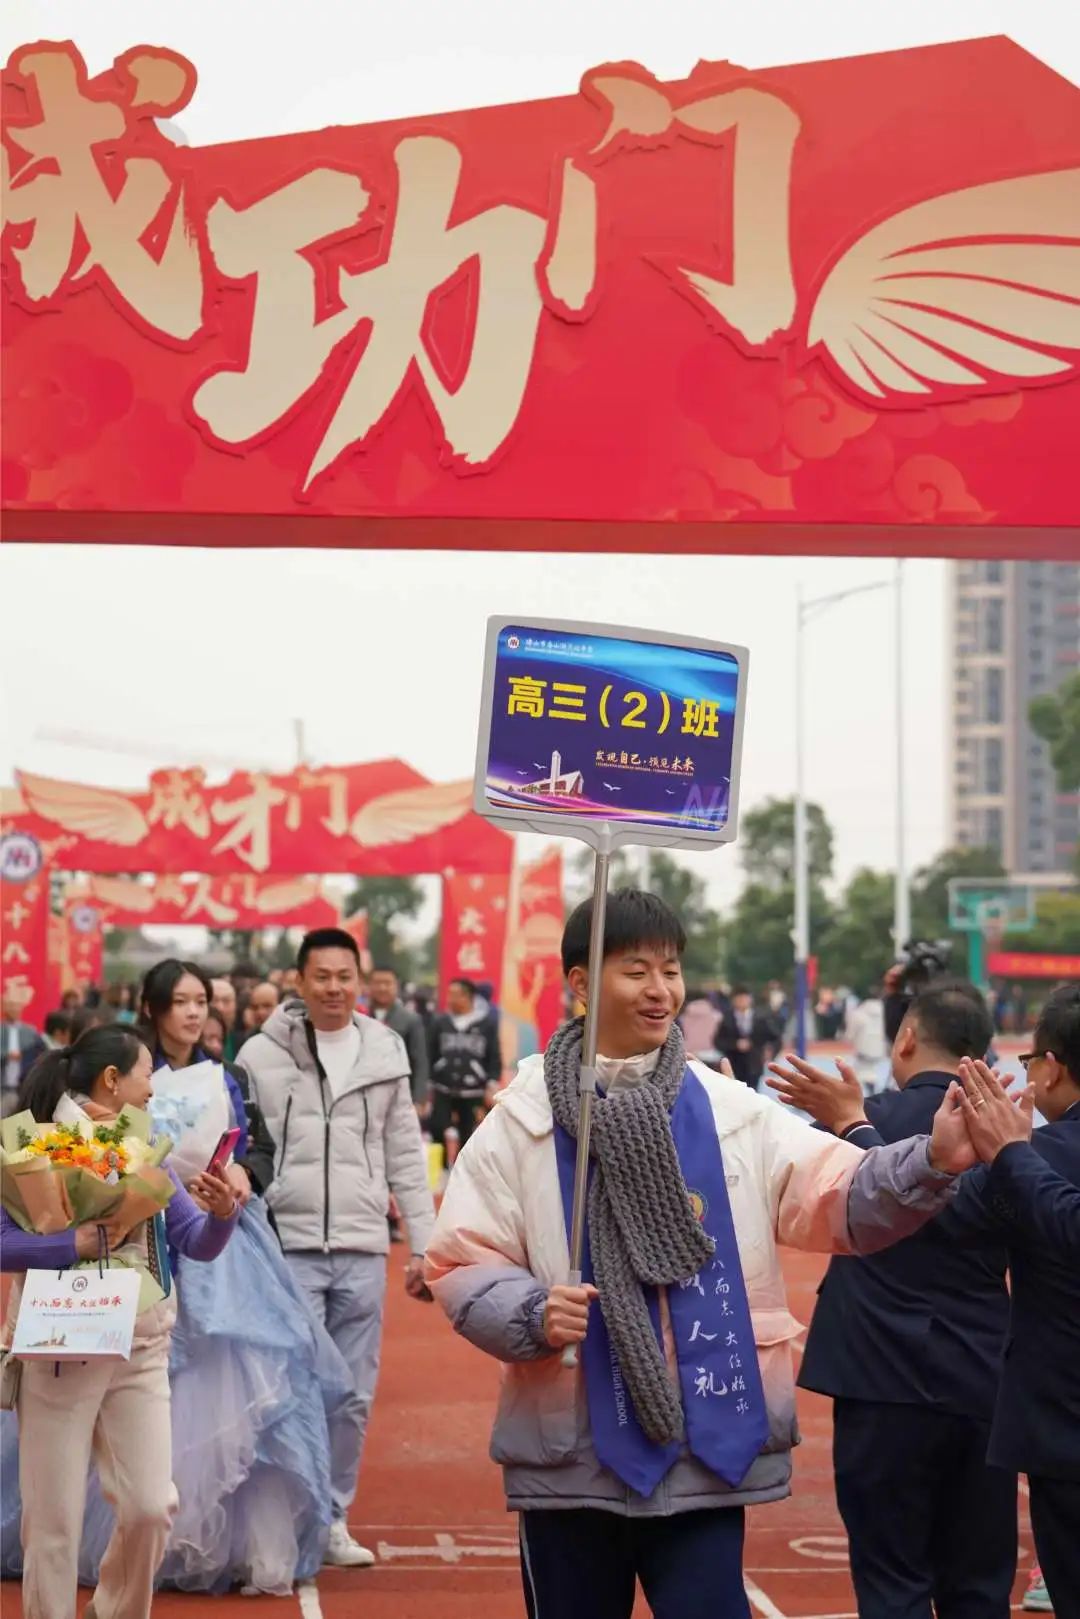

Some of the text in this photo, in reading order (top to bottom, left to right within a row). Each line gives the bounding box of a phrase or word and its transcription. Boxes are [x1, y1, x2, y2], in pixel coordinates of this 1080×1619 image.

[0, 51, 801, 493] 成功门
[507, 675, 721, 738] 高三（2）班
[147, 768, 349, 874] 成才门
[614, 1389, 628, 1427] SCHOOL
